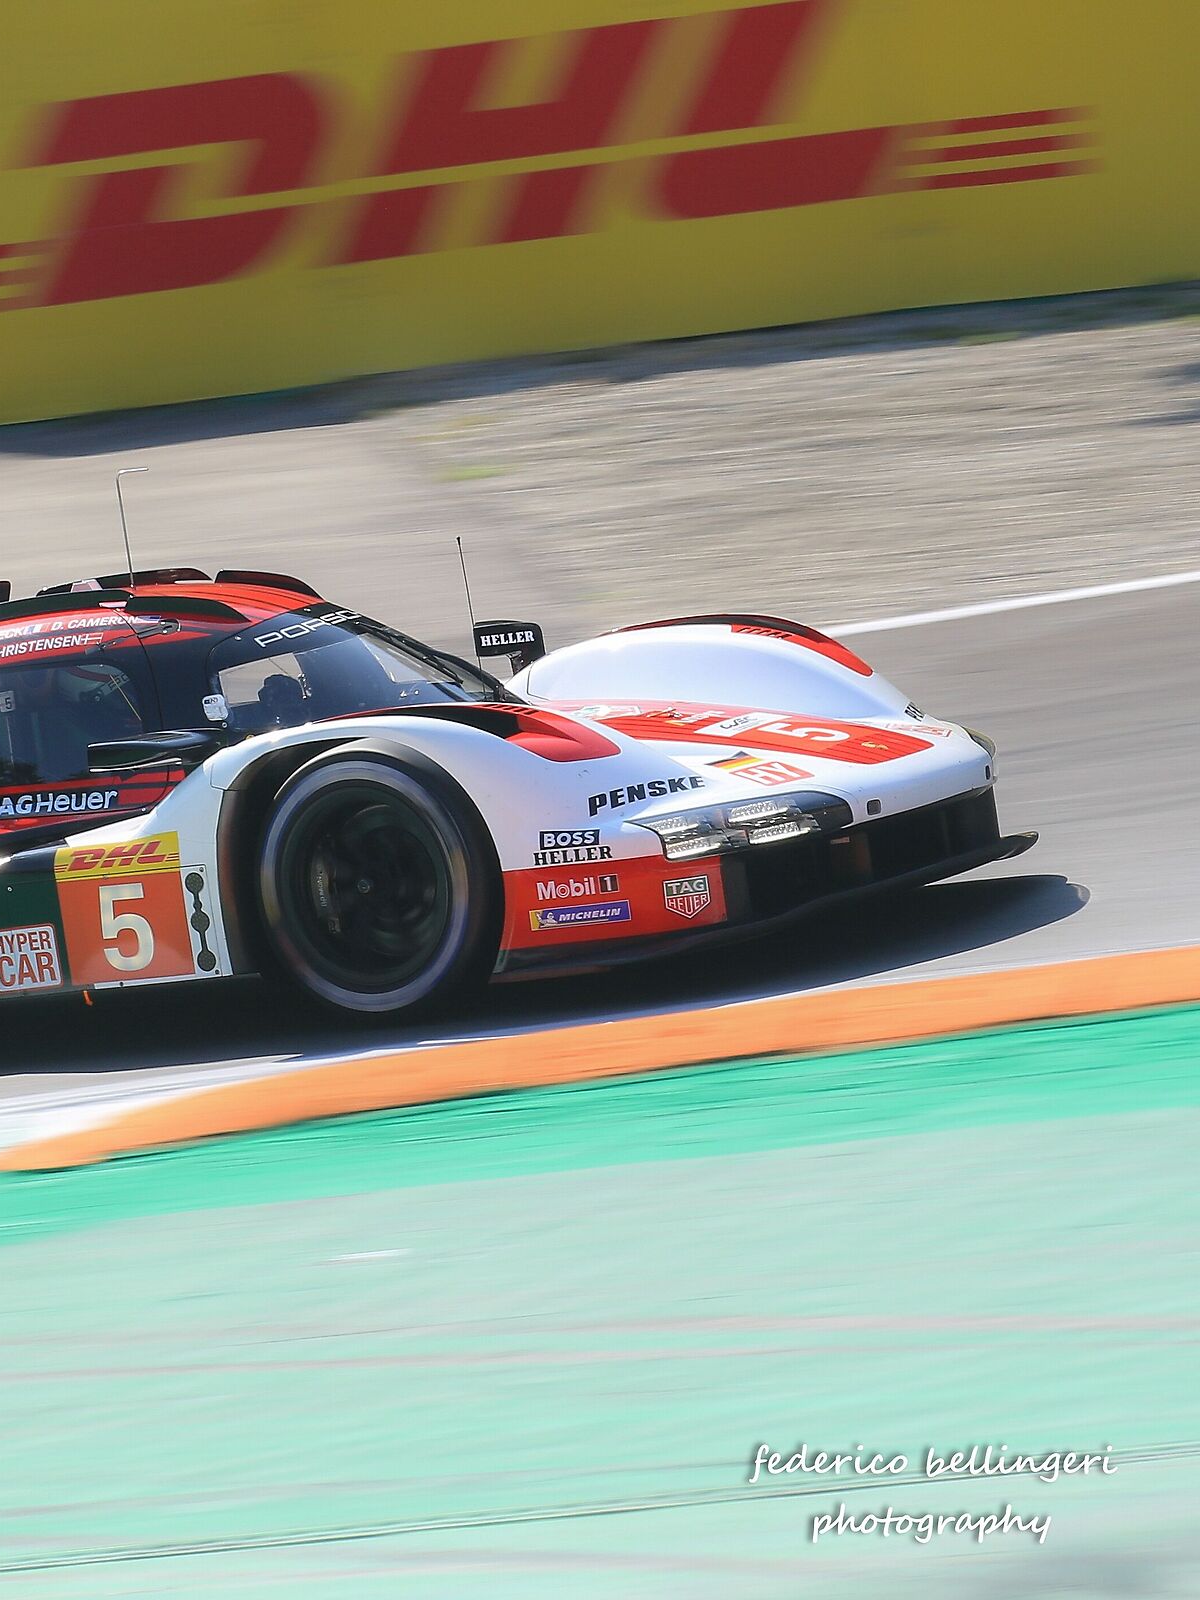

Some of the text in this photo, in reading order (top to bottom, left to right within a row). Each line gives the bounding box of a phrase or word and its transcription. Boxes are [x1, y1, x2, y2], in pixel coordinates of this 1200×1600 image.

[5, 0, 905, 307] DHL
[67, 616, 138, 629] CAMERON
[480, 630, 535, 647] HELLER
[756, 722, 850, 742] 5
[745, 762, 804, 784] HY
[588, 776, 705, 817] PENSKE
[543, 832, 596, 848] BOSS
[69, 841, 167, 871] DHL
[533, 846, 613, 866] HELLER
[536, 877, 596, 901] Mobil
[667, 878, 706, 895] TAG
[559, 908, 621, 922] MICHELIN
[667, 895, 708, 915] HEUER
[99, 883, 154, 972] 5
